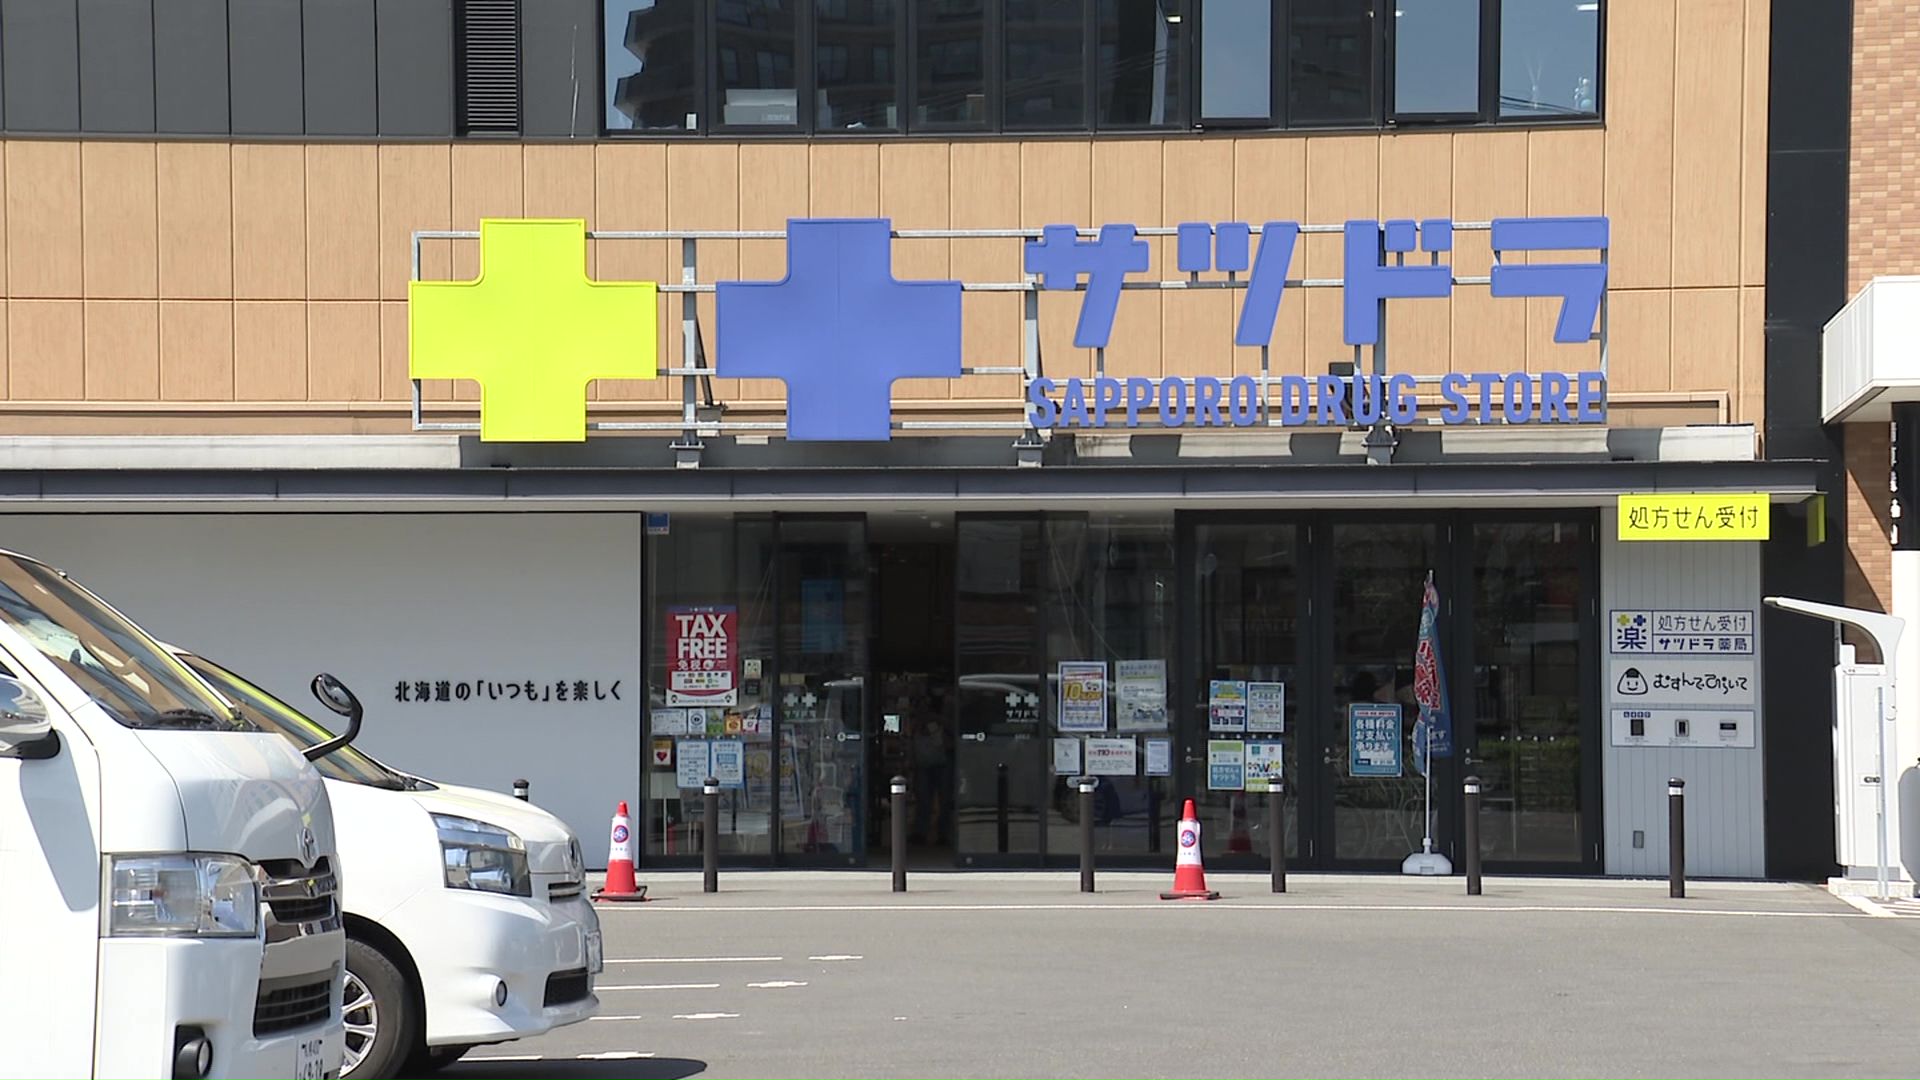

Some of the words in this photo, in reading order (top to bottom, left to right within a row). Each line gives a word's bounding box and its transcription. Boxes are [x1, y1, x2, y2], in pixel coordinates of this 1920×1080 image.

[1024, 216, 1609, 348] サツドラ
[1029, 375, 1258, 429] SAPPORO
[1281, 374, 1417, 426] DRUG
[1440, 371, 1606, 425] STORE
[1629, 505, 1758, 529] 処方せん受付
[675, 614, 728, 638] TAX
[1658, 615, 1747, 632] 処方せん受付
[678, 638, 727, 659] FREE
[1658, 637, 1747, 651] サツドラ薬局
[395, 680, 621, 702] 北海道の「いつも」を楽しく
